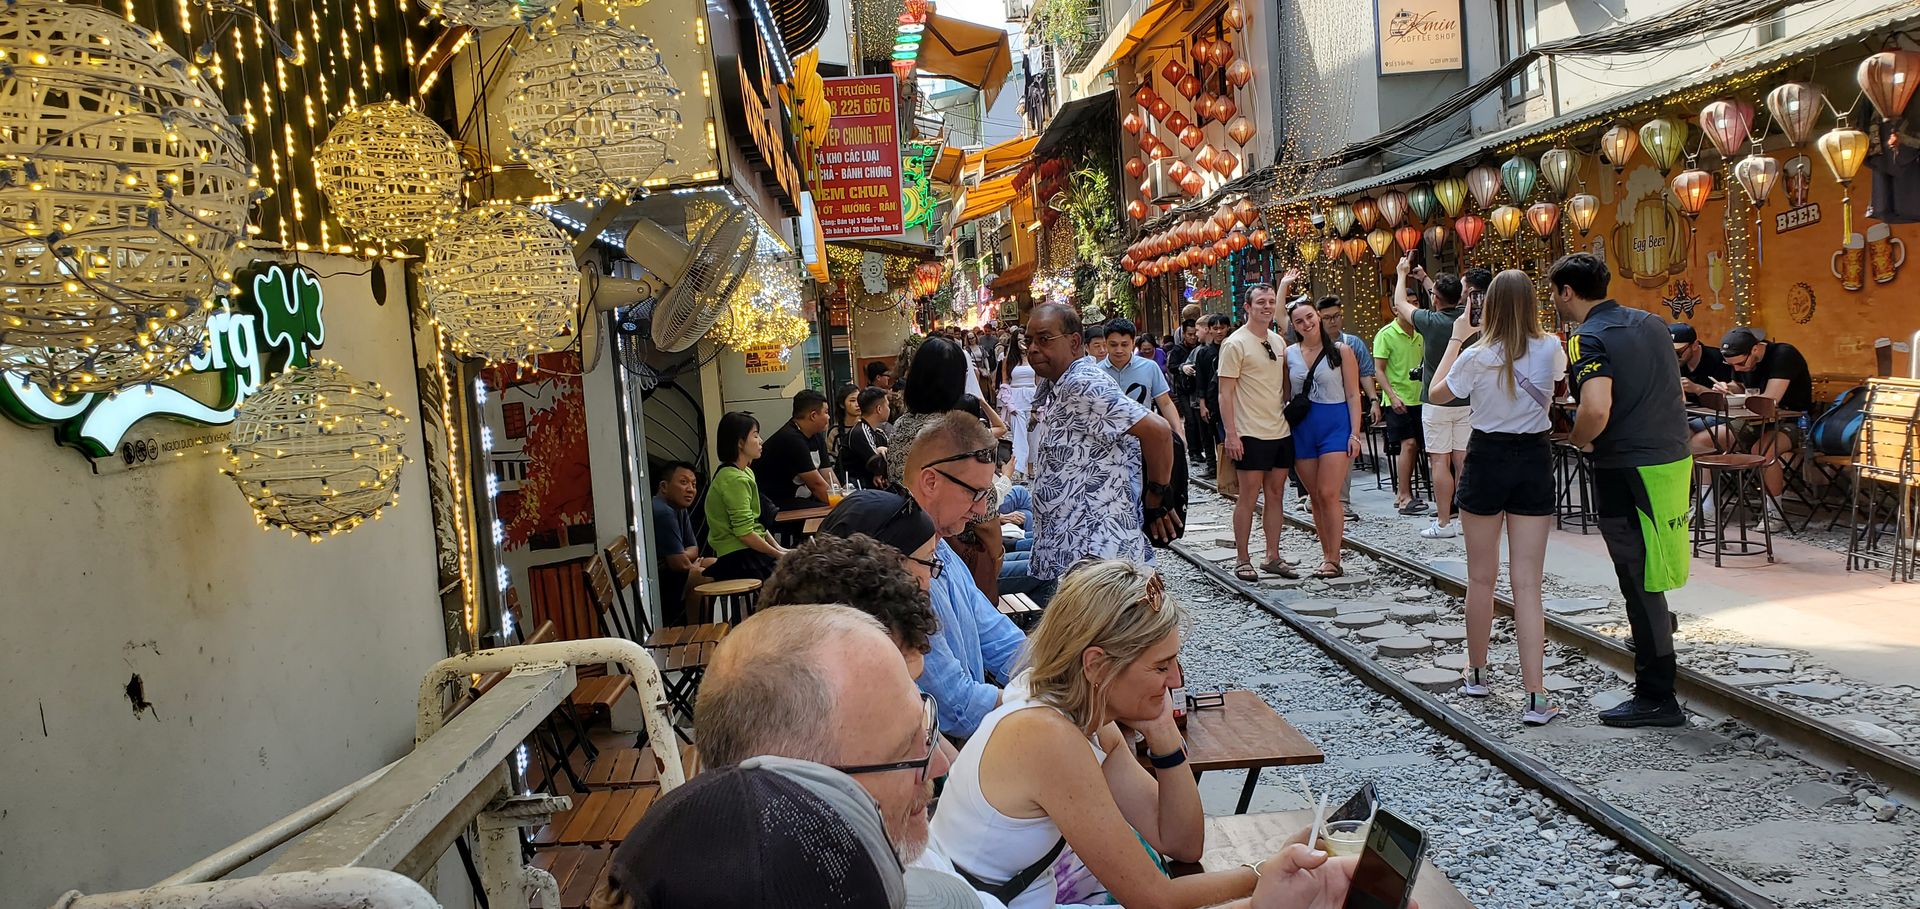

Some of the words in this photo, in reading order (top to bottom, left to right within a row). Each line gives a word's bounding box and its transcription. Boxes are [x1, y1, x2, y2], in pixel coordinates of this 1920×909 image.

[1401, 34, 1431, 43] COFFEE
[837, 80, 881, 97] TRƯỜNG
[840, 99, 861, 115] 225
[863, 97, 891, 114] 6676
[842, 125, 873, 146] CHƯNG
[874, 124, 892, 146] THỊT
[826, 152, 842, 164] KHO
[844, 148, 860, 163] CÁC
[861, 150, 880, 164] LOẠI
[841, 165, 863, 180] BÁNH
[864, 165, 892, 178] CHƯNG
[849, 184, 889, 200] CHUA
[841, 200, 871, 213] NƯỚNG
[1776, 204, 1820, 231] BEER
[1633, 237, 1647, 252] Egg
[1648, 234, 1666, 248] Beer
